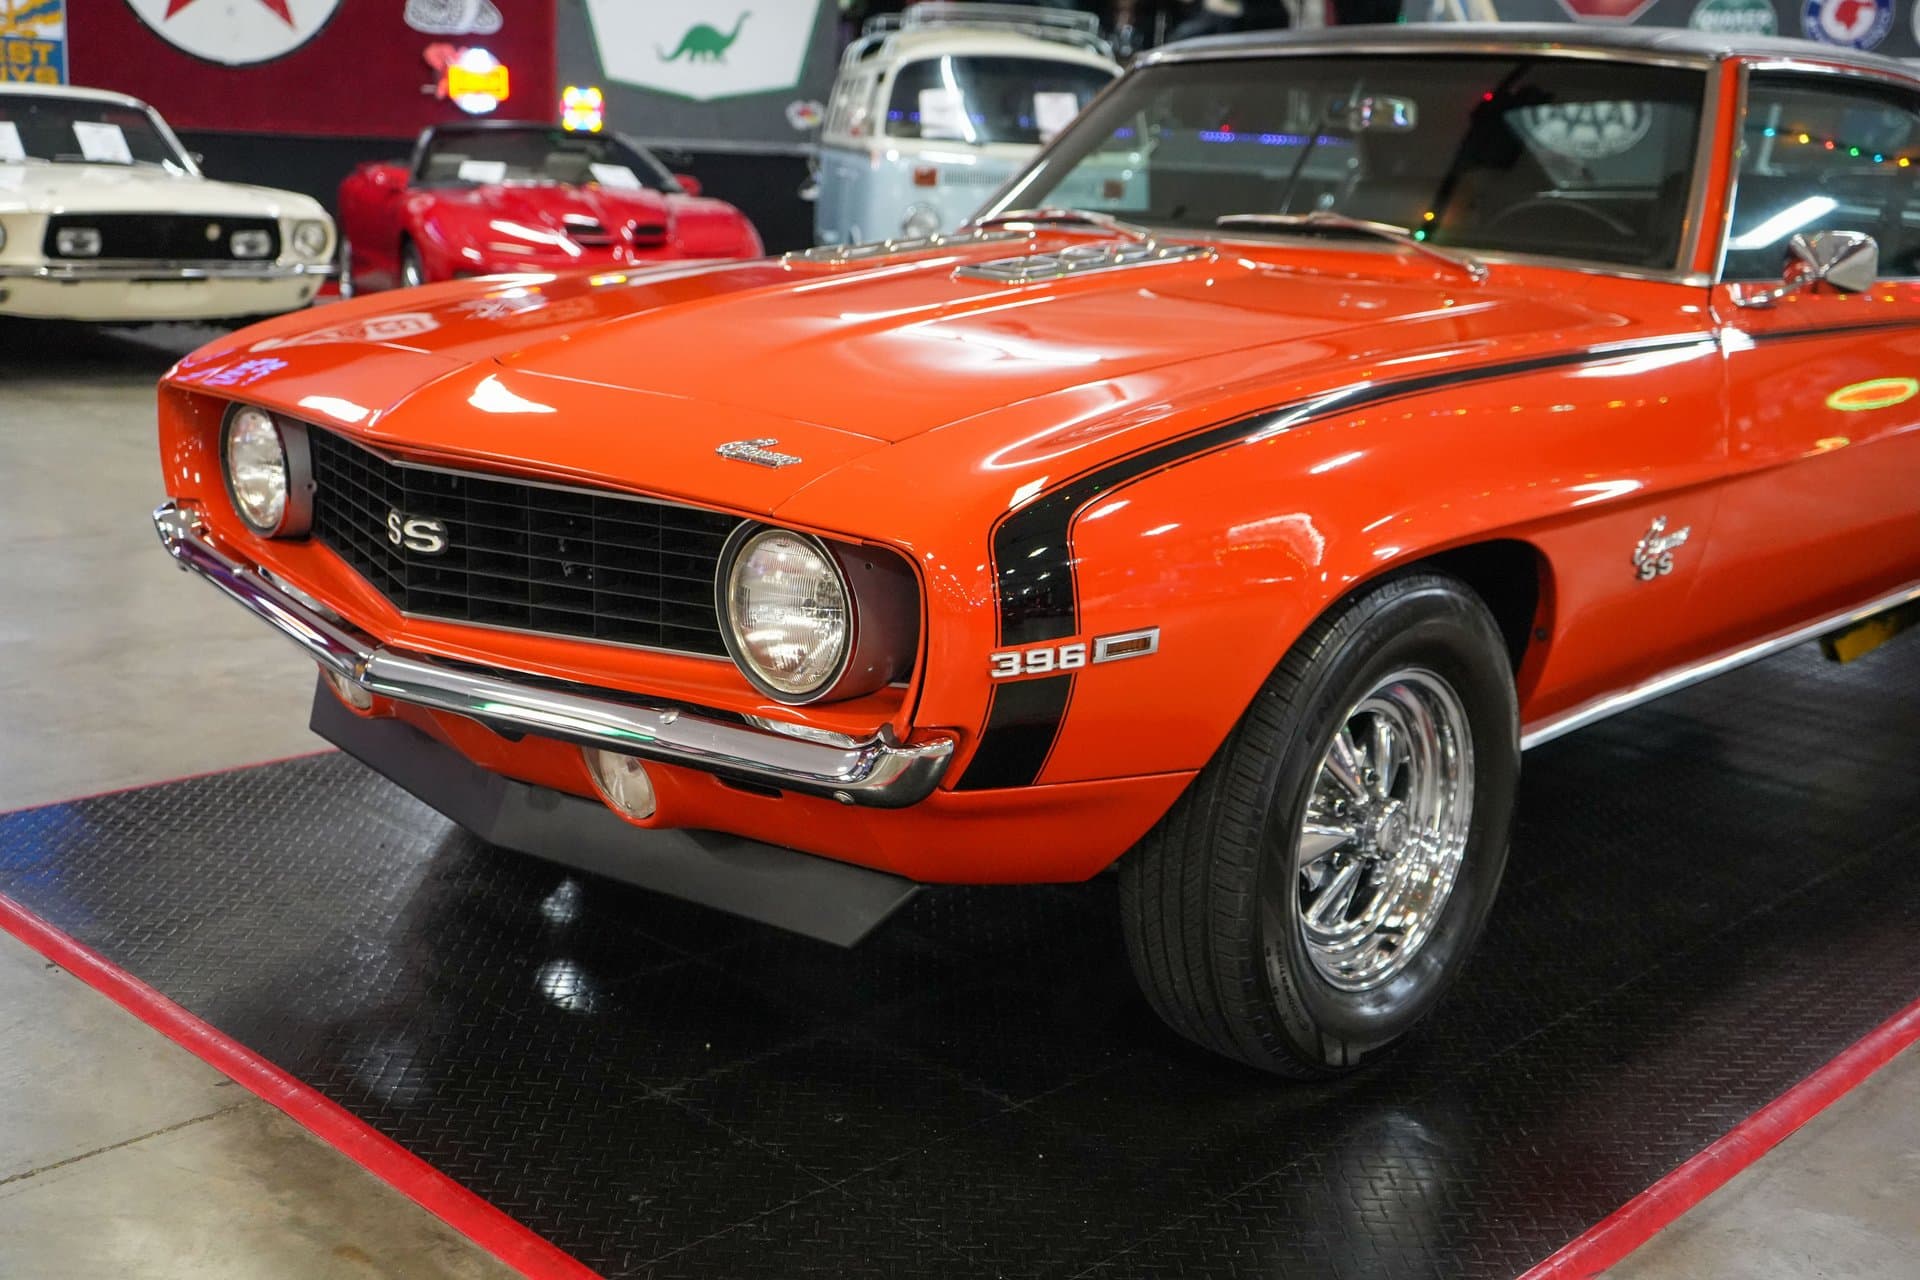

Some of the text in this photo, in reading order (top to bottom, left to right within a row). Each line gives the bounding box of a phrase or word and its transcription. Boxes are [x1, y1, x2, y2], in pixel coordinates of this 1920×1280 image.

[0, 41, 55, 65] ST
[387, 512, 444, 553] SS
[1640, 551, 1674, 581] SS
[990, 642, 1086, 678] 396
